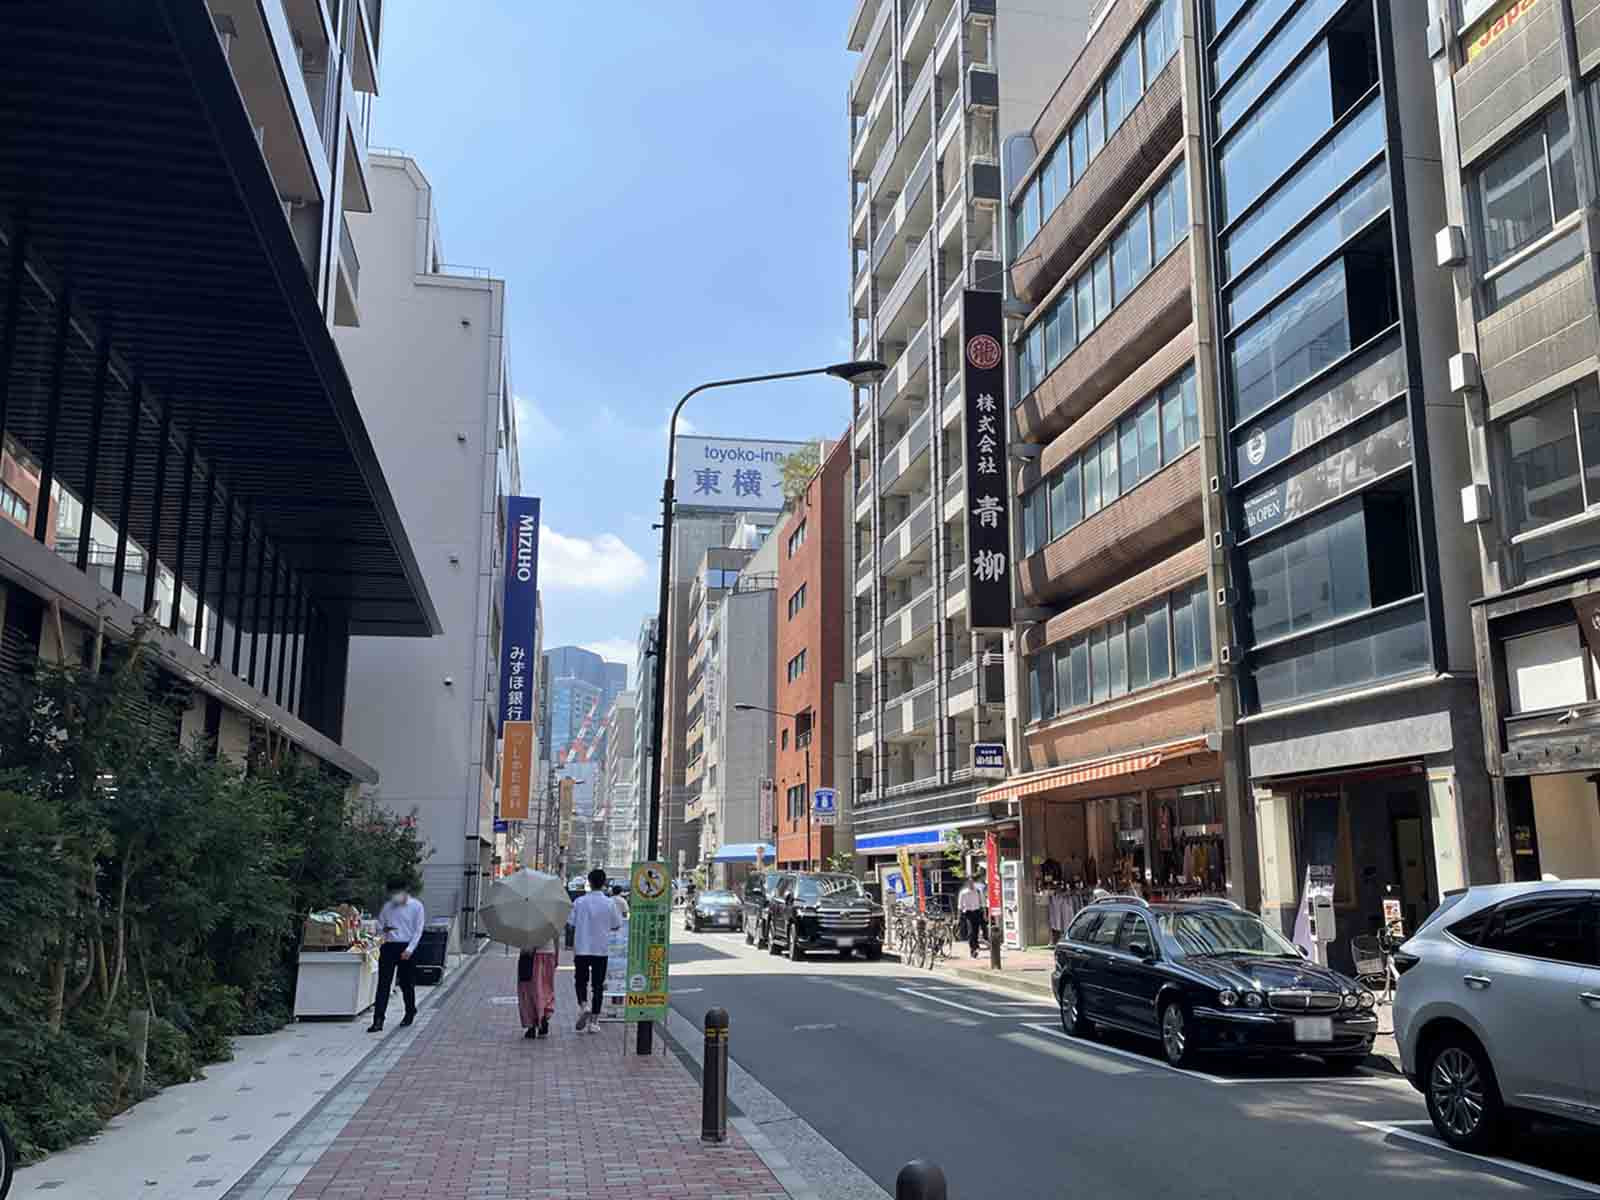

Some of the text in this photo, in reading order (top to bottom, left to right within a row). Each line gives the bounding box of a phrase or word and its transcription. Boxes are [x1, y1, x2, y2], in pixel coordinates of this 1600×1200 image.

[972, 393, 1006, 582] 株式会社 青柳
[1256, 500, 1280, 522] OPEN
[516, 514, 534, 582] MIZUHO
[507, 645, 525, 721] みずほ銀行
[629, 995, 645, 1006] No
